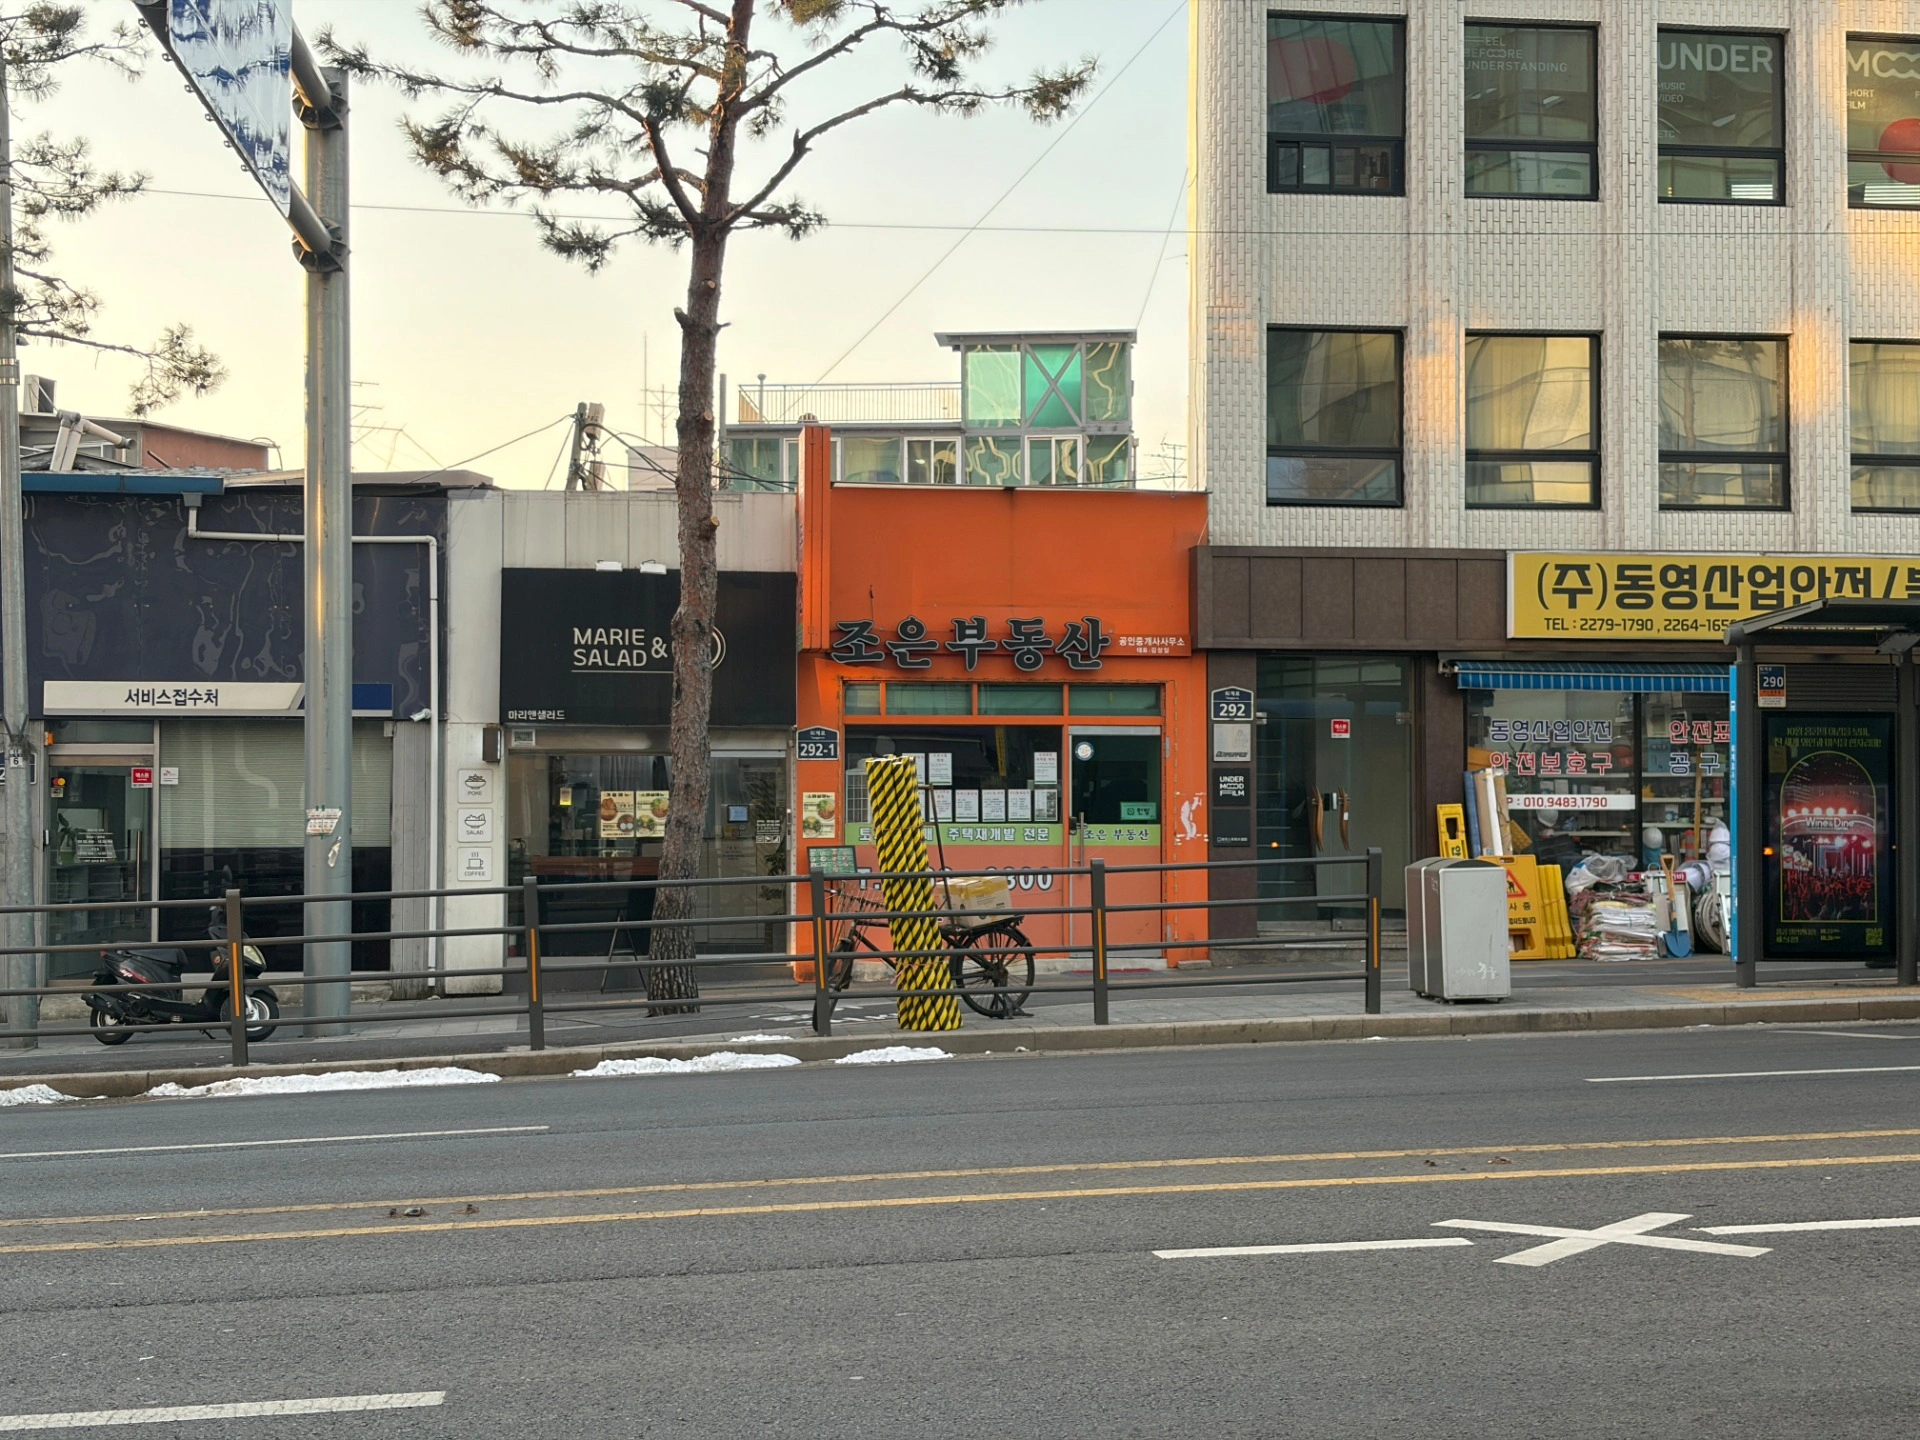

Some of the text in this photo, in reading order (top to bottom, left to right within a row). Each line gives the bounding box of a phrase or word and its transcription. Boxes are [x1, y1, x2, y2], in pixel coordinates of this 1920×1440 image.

[1657, 42, 1773, 73] UNDER
[1663, 618, 1737, 632] 2264-165
[573, 627, 668, 659] MARIE &
[831, 614, 1112, 672] 조은부동산
[573, 649, 647, 667] SALAD
[1763, 676, 1784, 687] 290
[124, 687, 219, 707] 서비스접수처
[1219, 703, 1246, 717] 292
[1489, 719, 1613, 744] 동영산업안전
[800, 743, 835, 757] 292-1
[13, 757, 19, 766] 6
[1219, 775, 1244, 783] UNDER
[948, 827, 1016, 842] 주택재개발
[1023, 827, 1050, 842] 전문
[1113, 829, 1150, 841] 부동산
